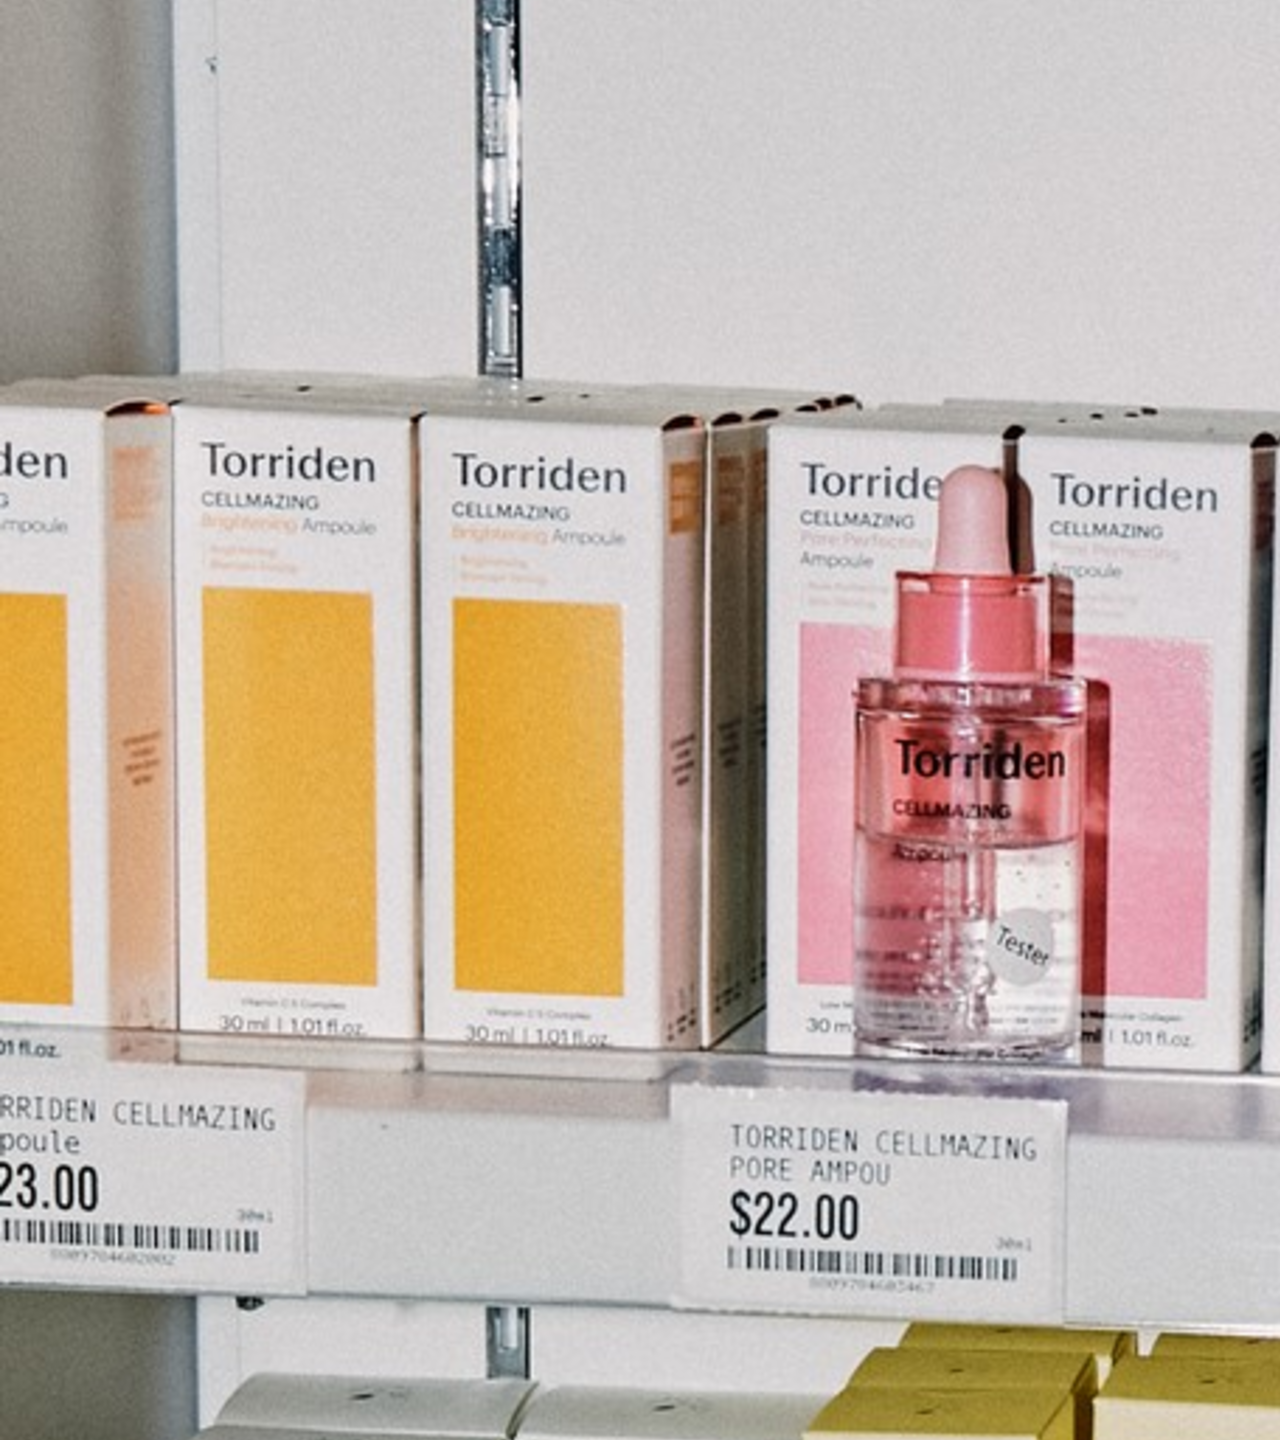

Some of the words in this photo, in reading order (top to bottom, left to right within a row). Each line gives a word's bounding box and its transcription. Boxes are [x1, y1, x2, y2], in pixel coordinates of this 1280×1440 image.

[202, 442, 376, 483] Torriden
[453, 453, 627, 493] Torriden
[202, 491, 320, 510] CELLMAZING
[452, 501, 571, 520] CELLMAZING
[1050, 474, 1219, 512] Torriden
[1050, 520, 1164, 540] CELLMAZING
[896, 737, 1066, 782] Torriden
[113, 1101, 276, 1132] CELLMAZING
[731, 1124, 858, 1153] TORRIDEN
[875, 1129, 1037, 1162] CELLMAZING
[730, 1156, 792, 1182] PORE
[811, 1159, 891, 1185] AMPOU
[729, 1190, 859, 1241] $22.00
